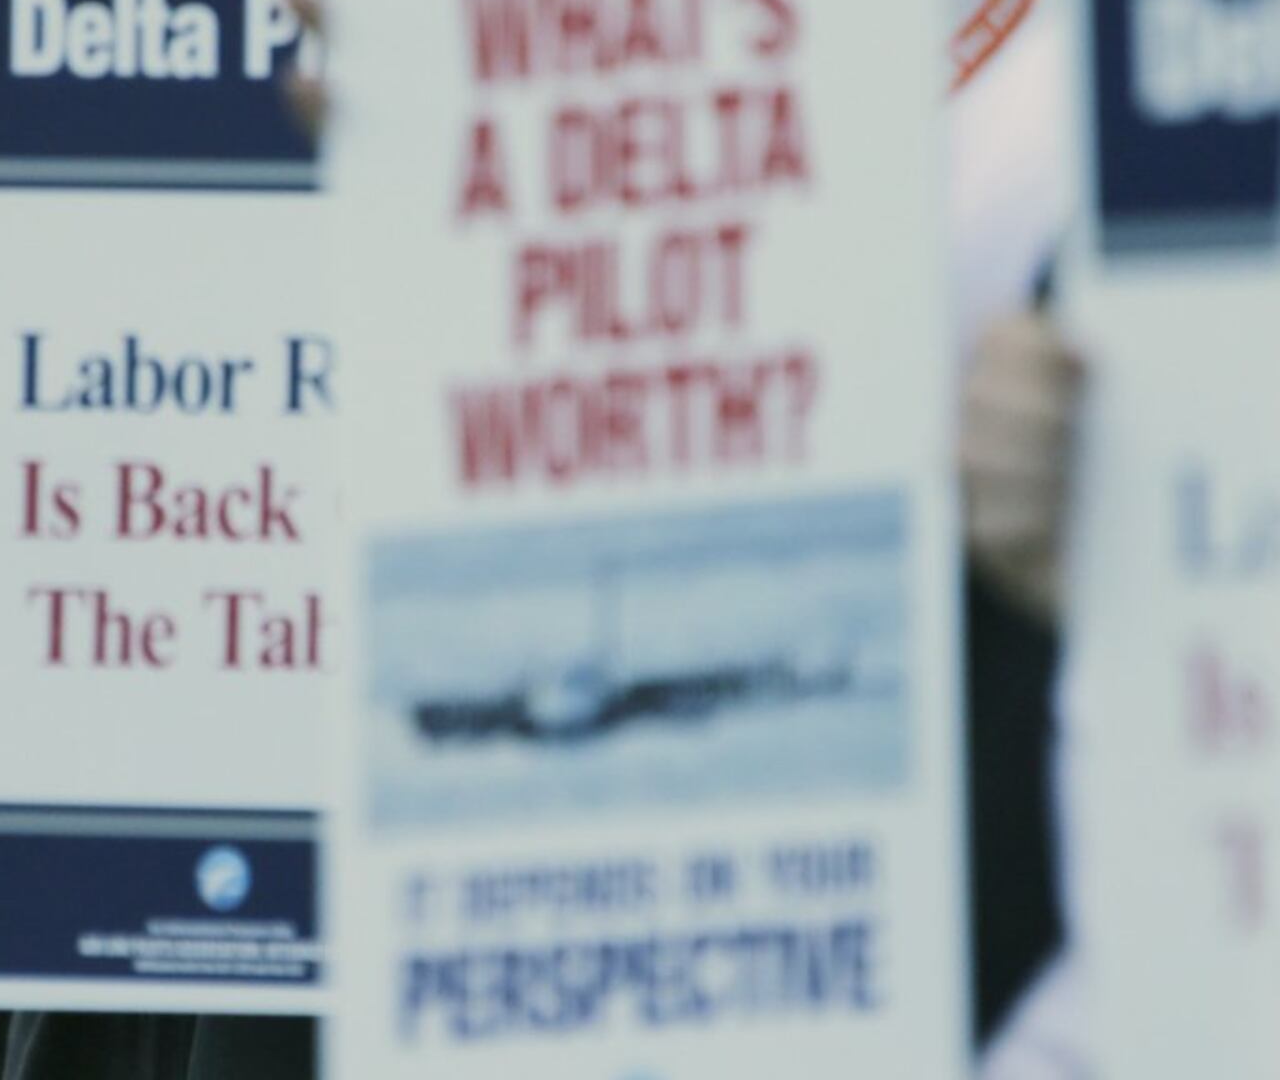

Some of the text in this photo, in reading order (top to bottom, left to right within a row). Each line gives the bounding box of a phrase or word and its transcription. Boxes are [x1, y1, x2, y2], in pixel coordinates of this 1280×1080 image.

[456, 84, 808, 218] A DELTA
[511, 223, 748, 350] PILOT
[18, 329, 254, 413] Labor
[449, 348, 822, 492] WORTH?
[18, 459, 304, 541] Is Back
[26, 585, 179, 668] The
